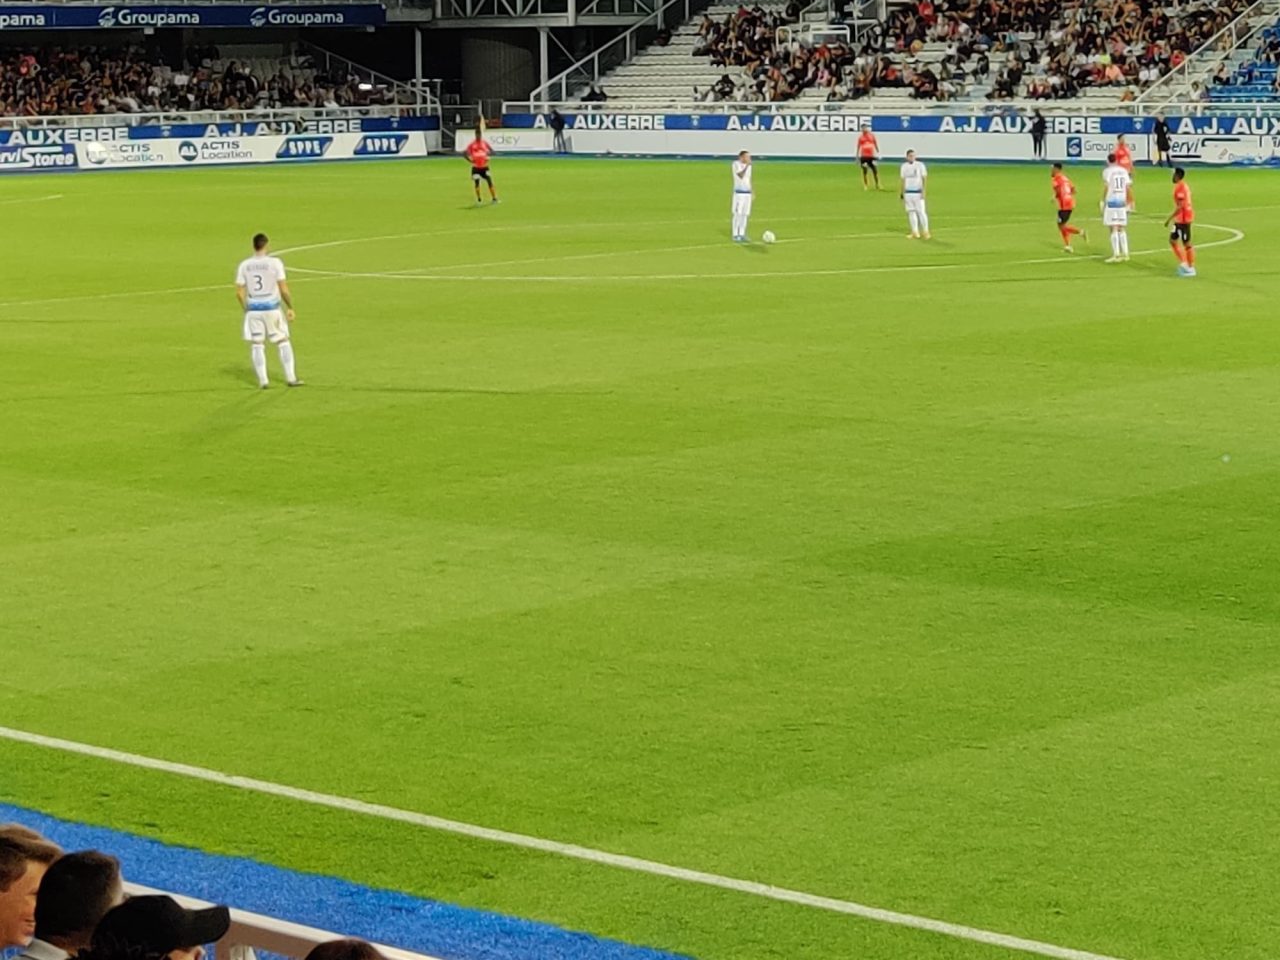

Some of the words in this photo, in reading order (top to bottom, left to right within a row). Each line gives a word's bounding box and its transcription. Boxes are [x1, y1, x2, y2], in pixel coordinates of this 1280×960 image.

[118, 10, 200, 26] Groupama
[269, 10, 345, 25] Groupama
[574, 114, 665, 130] AUXERRE
[726, 116, 765, 131] A.J.
[771, 115, 873, 132] AUXERRE
[939, 116, 982, 133] A.J.
[1177, 118, 1225, 135] A.J.
[8, 127, 129, 145] AUXERRE
[203, 124, 247, 138] A.J.
[201, 140, 240, 150] ACTIS
[22, 146, 75, 167] Stores
[201, 150, 253, 160] Location
[253, 274, 264, 292] 3
